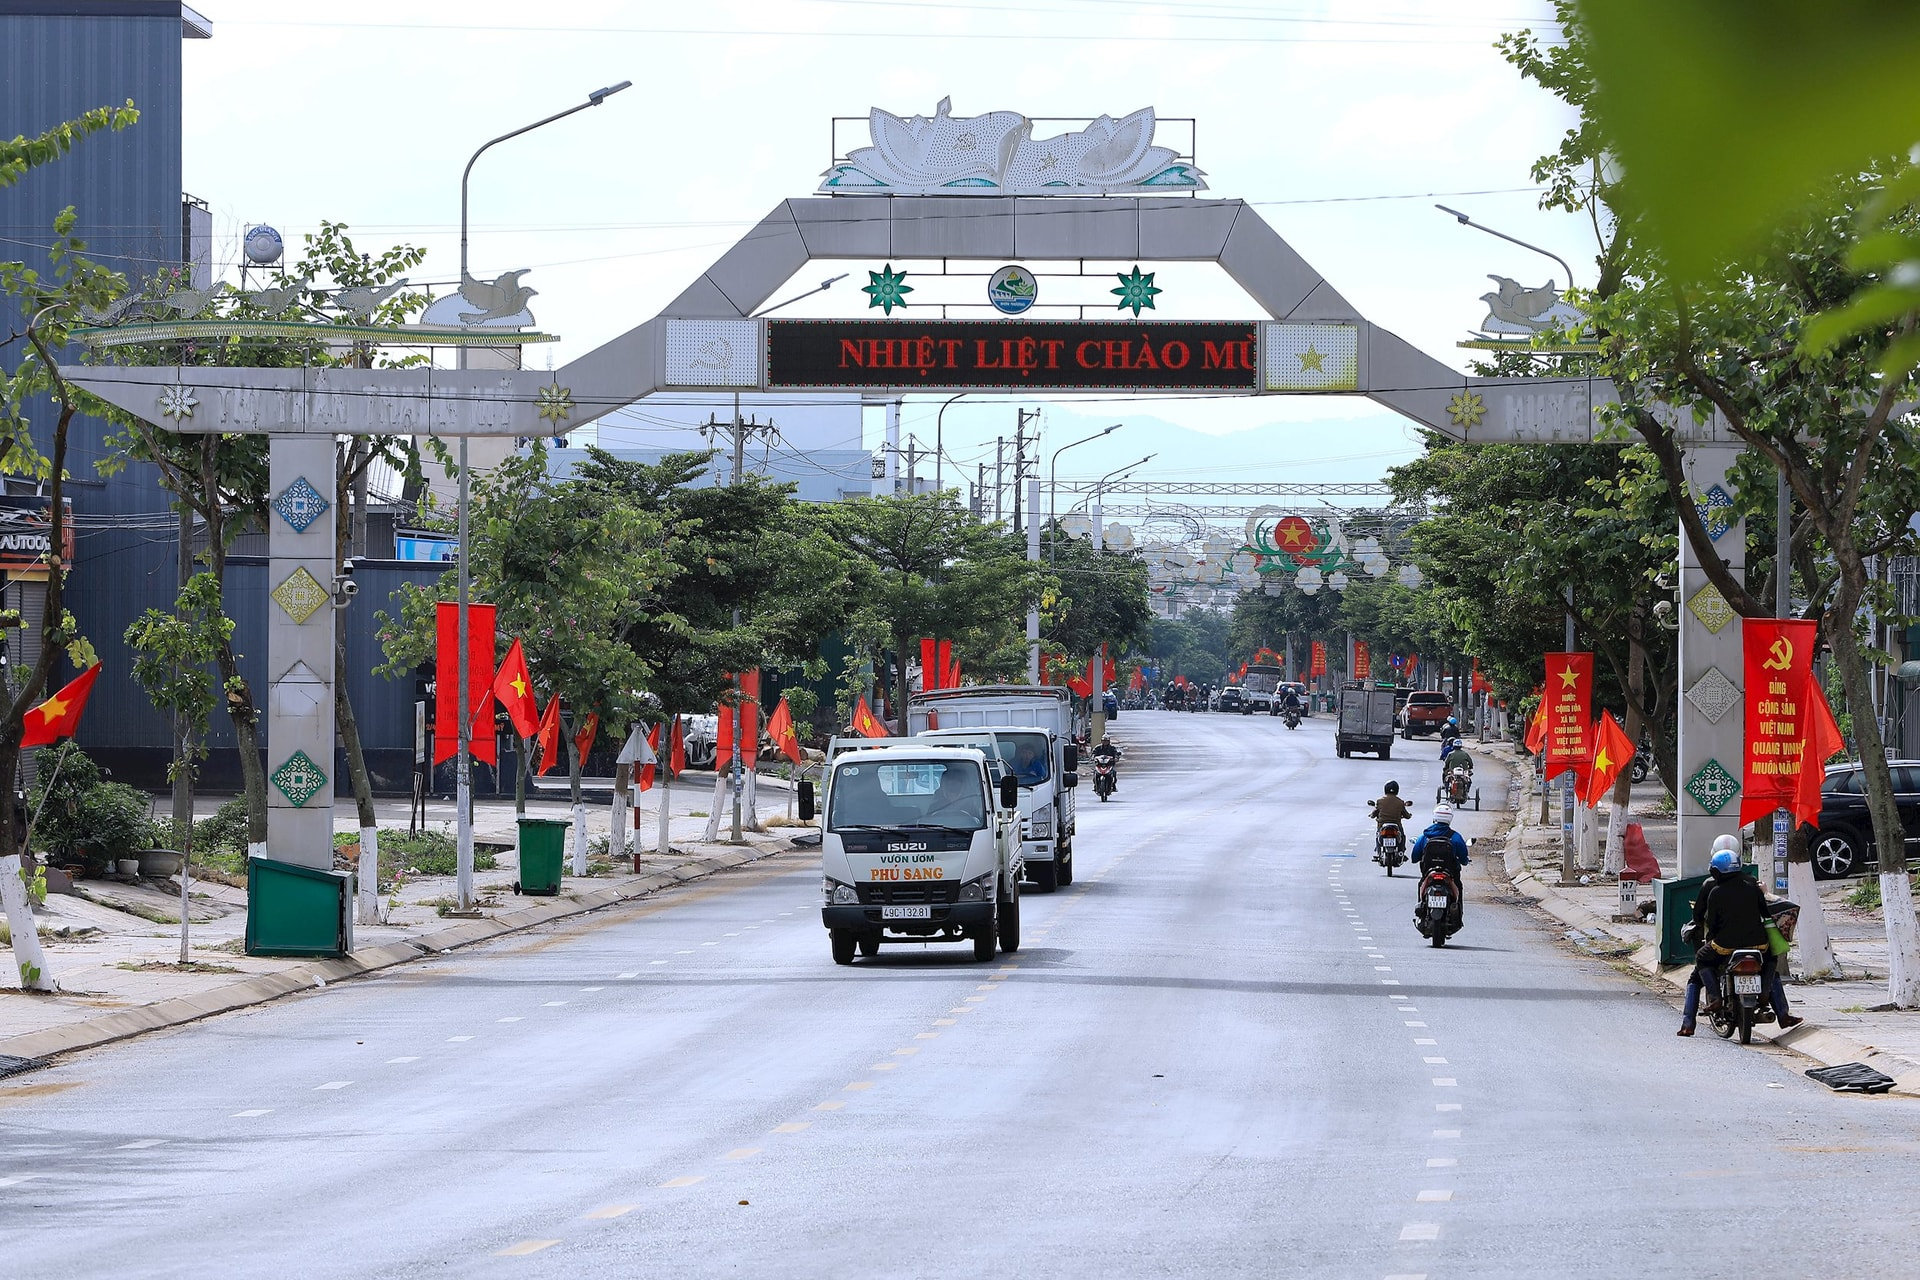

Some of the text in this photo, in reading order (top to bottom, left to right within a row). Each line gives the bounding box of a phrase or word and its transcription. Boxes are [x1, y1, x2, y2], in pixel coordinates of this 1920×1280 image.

[838, 335, 963, 377] NHIỆT
[973, 335, 1065, 377] LIỆT
[1076, 333, 1191, 369] CHÀO
[887, 842, 927, 852] ISUZU
[911, 853, 935, 863] ƯƠM
[870, 864, 944, 881] PHÚ SANG
